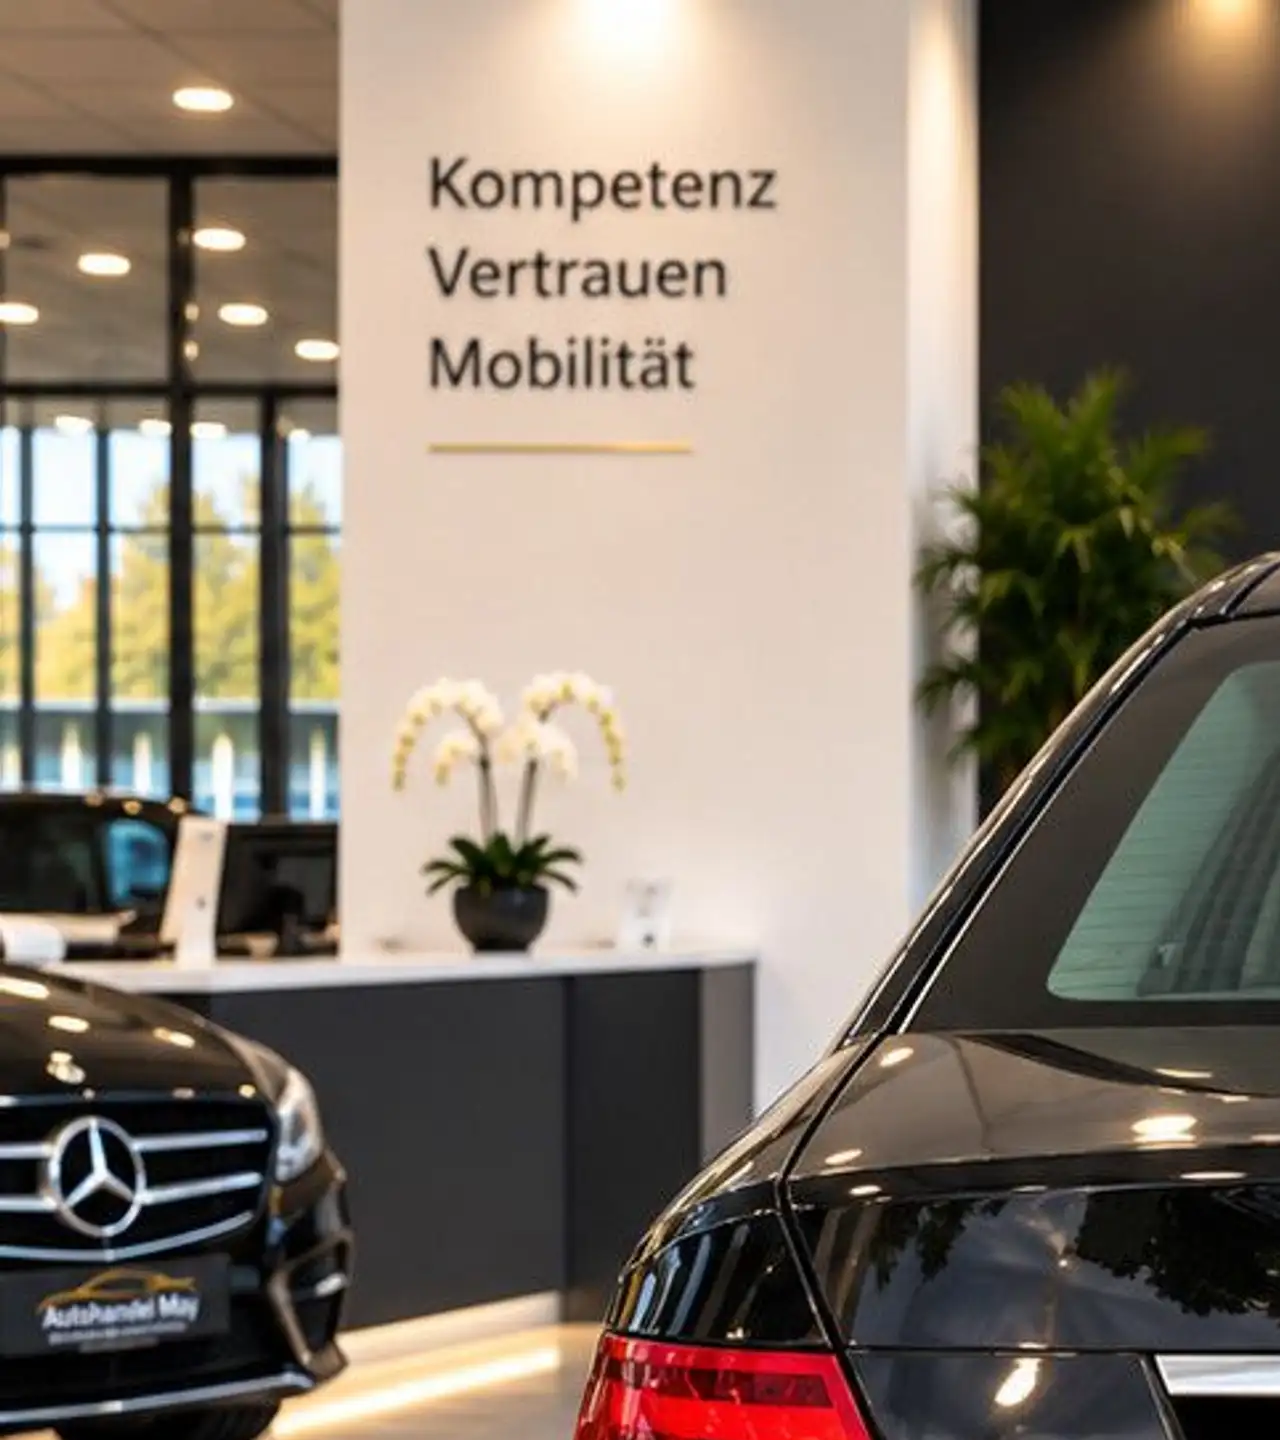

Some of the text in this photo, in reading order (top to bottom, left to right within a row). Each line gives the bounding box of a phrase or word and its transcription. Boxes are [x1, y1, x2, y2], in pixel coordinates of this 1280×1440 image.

[429, 156, 776, 222] Kompetenz
[428, 246, 728, 298] Vertrauen
[429, 336, 694, 390] Mobilität
